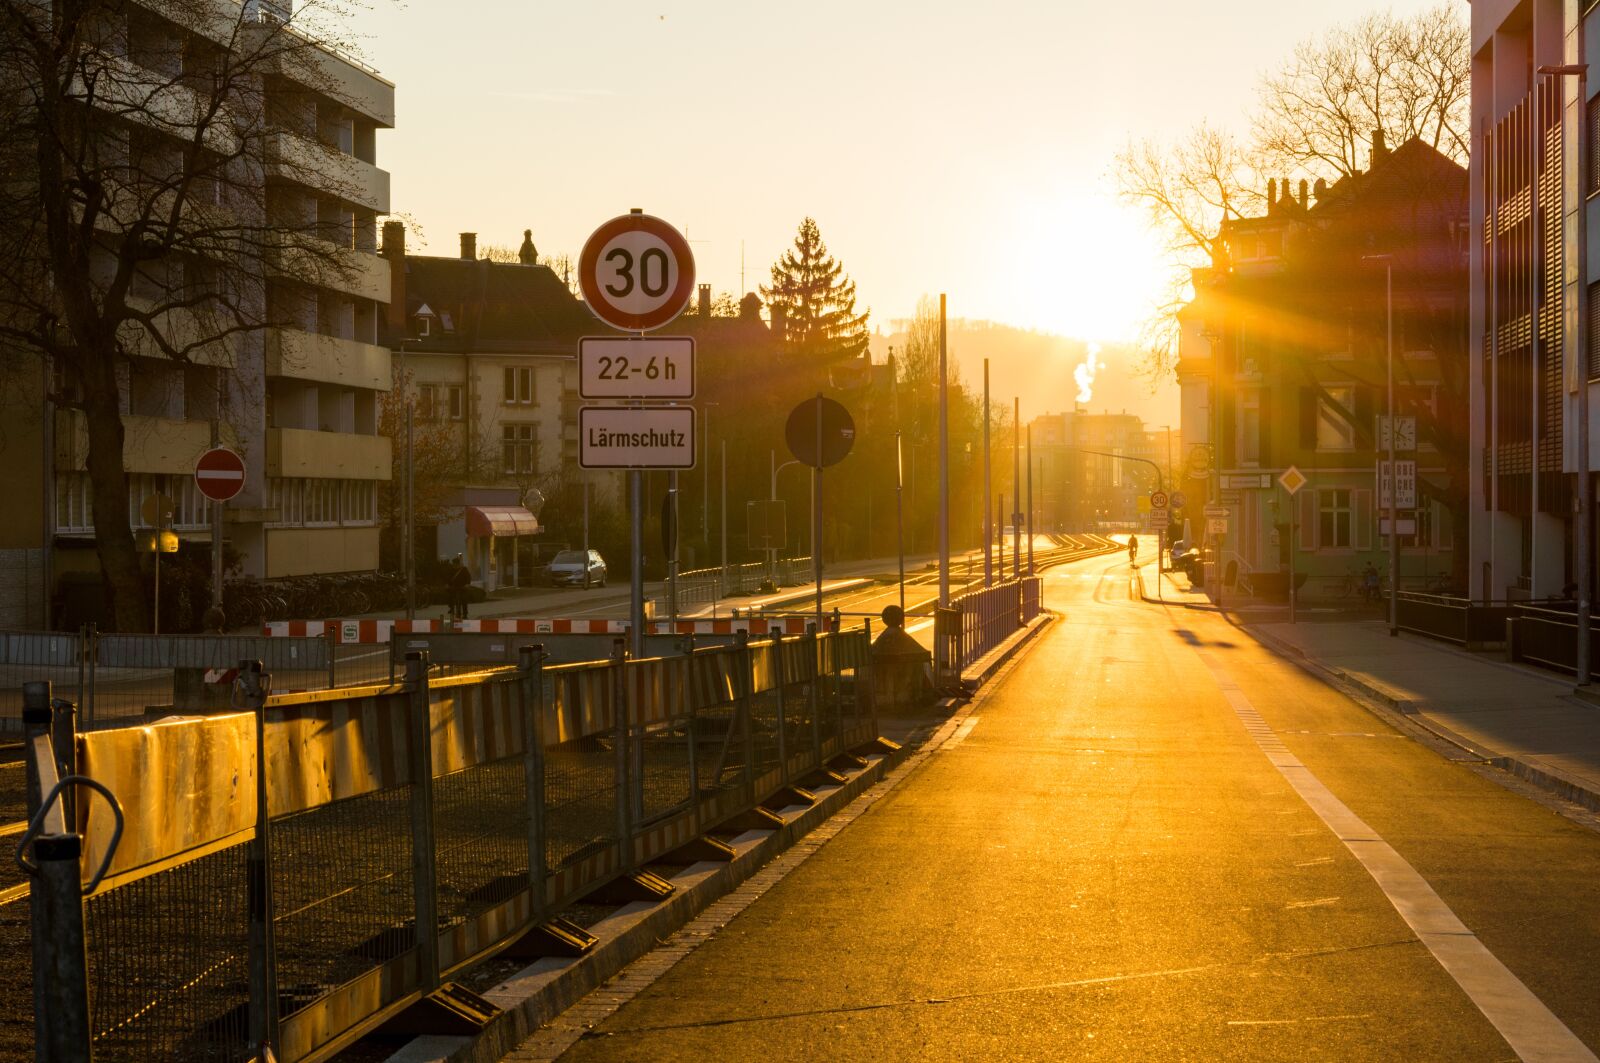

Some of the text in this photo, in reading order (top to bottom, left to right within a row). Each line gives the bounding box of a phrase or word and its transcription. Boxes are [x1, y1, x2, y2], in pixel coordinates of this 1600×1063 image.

[605, 247, 668, 298] 30
[664, 356, 676, 380] h
[589, 427, 685, 448] Lärmschutz
[1384, 464, 1413, 476] WRBE
[1154, 496, 1165, 504] 30
